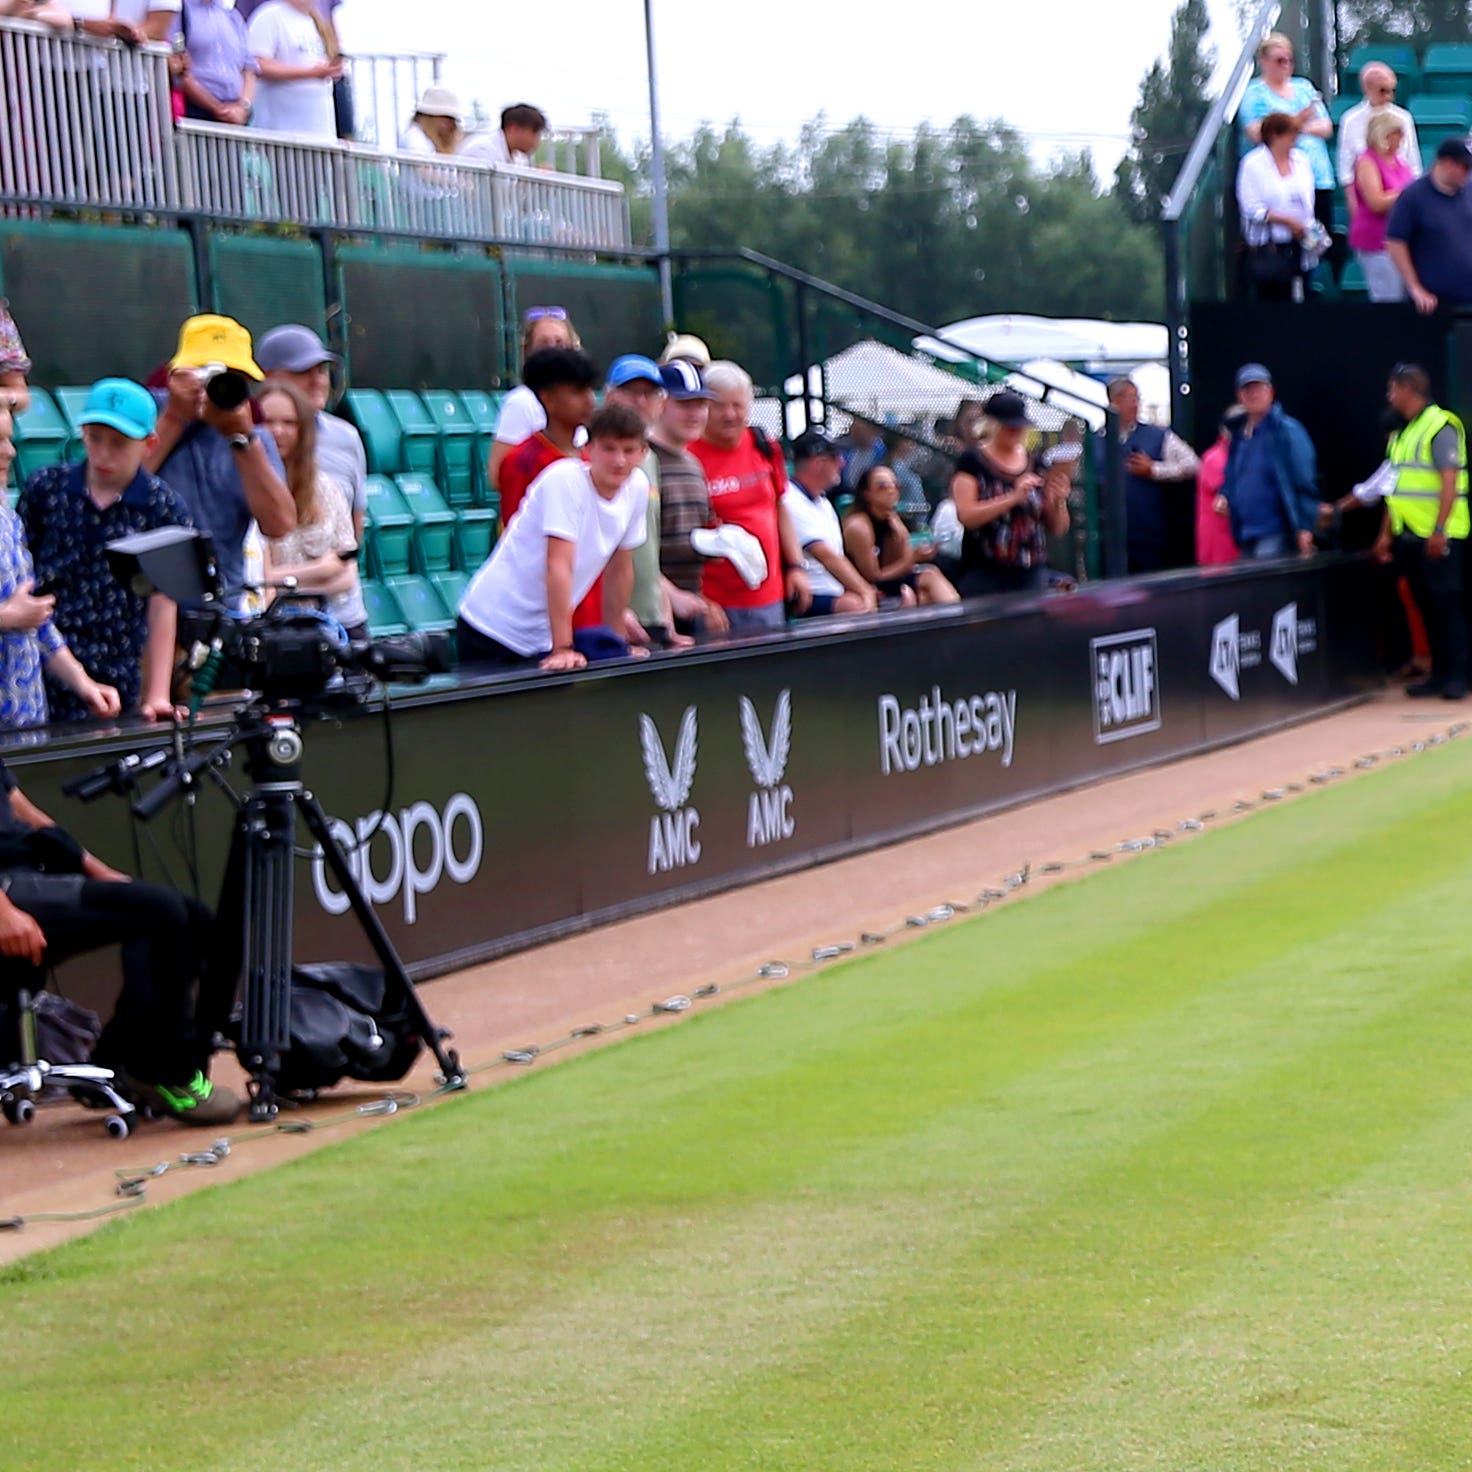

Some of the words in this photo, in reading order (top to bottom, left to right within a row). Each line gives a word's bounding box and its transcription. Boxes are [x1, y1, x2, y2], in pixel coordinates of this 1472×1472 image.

[878, 684, 1016, 776] Rothesay
[648, 806, 702, 874] AMC
[747, 784, 795, 848] AMC
[312, 792, 483, 924] oppo
